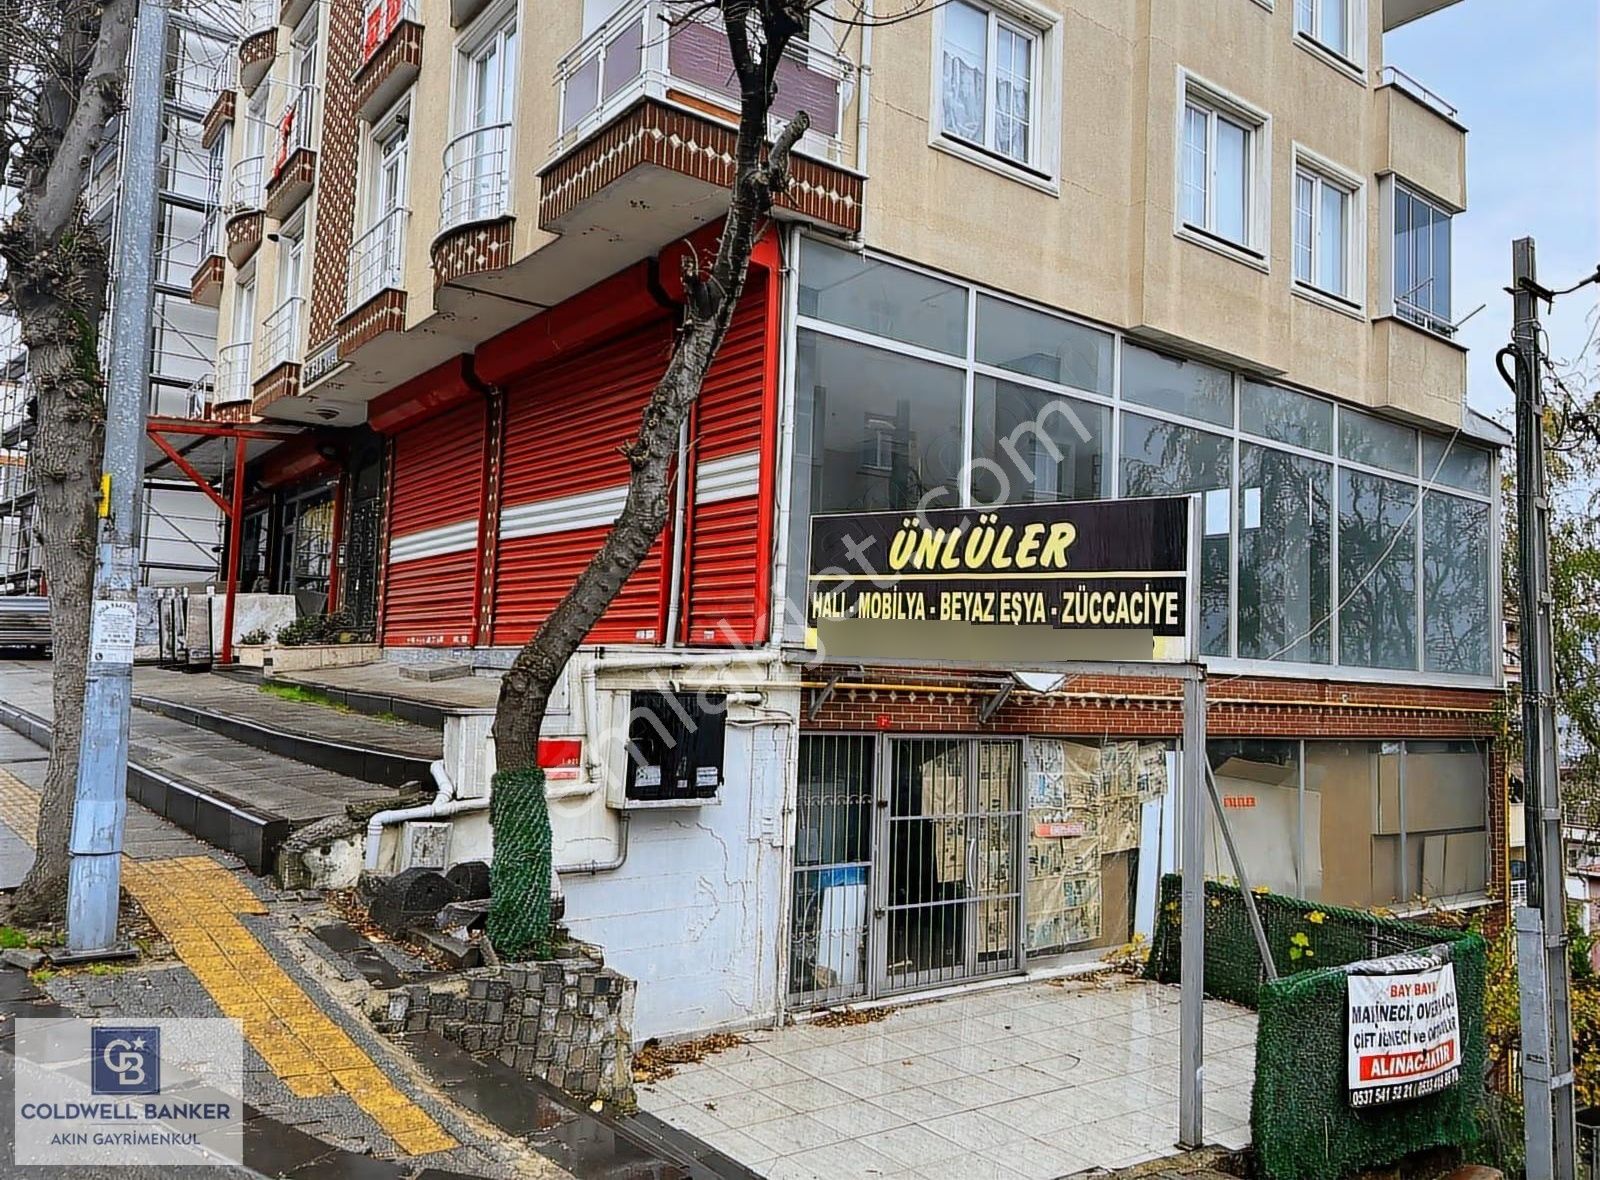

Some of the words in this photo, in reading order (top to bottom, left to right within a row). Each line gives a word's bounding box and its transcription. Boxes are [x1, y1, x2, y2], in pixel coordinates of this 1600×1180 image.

[888, 513, 1078, 571] ÜNLÜLER
[812, 591, 847, 619] HALI
[858, 586, 926, 621] MOBİLYA
[940, 591, 995, 622] BEYAZ
[1000, 591, 1046, 626] EŞYA
[1062, 585, 1178, 625] ZÜCCACİYE
[1390, 985, 1411, 998] BAY
